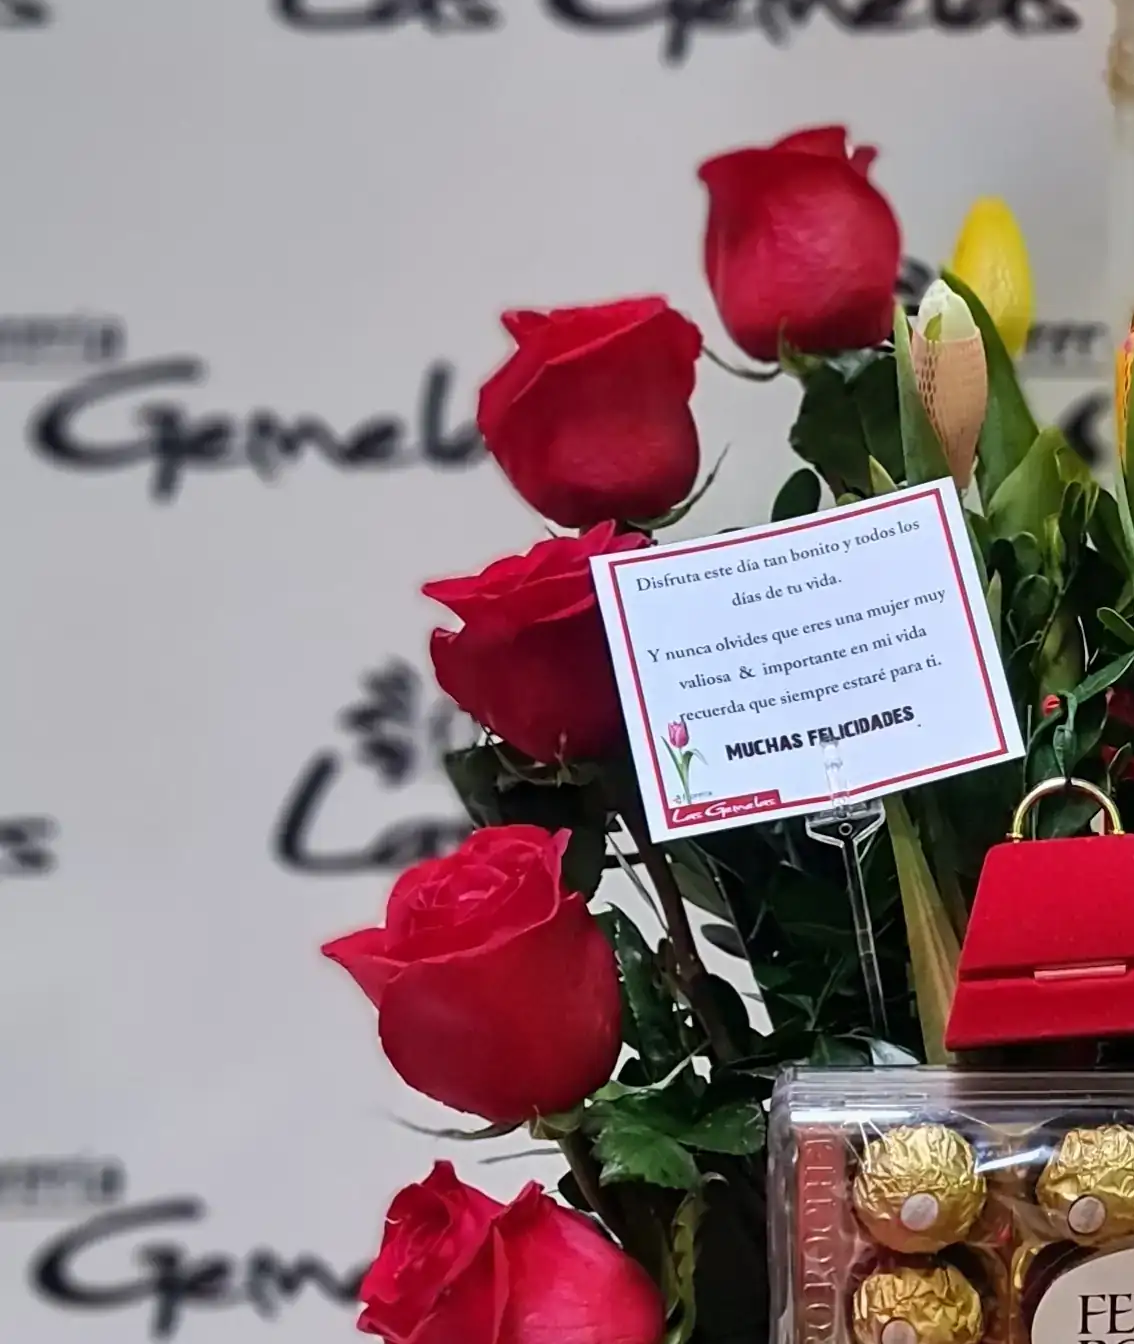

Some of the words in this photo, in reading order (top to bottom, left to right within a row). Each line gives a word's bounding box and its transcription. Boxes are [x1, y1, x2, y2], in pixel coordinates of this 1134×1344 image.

[28, 357, 486, 503] Gemel
[636, 573, 701, 591] Disfruta
[704, 567, 733, 580] este
[737, 559, 760, 573] día
[764, 554, 788, 567] tan
[789, 542, 840, 562] bonito
[842, 539, 851, 553] y
[854, 527, 896, 545] todos
[897, 520, 920, 534] los
[732, 592, 761, 606] días
[765, 586, 783, 599] de
[787, 583, 803, 595] tu
[806, 573, 842, 591] vida.
[647, 648, 660, 663] Y
[665, 644, 712, 661] nunca
[715, 632, 768, 651] olvides
[771, 627, 799, 645] que
[802, 619, 832, 634] eres
[834, 612, 863, 626] una
[866, 599, 909, 618] mujer
[913, 589, 945, 606] muy
[678, 673, 731, 690] valiosa
[739, 665, 756, 679] &
[762, 648, 847, 676] importante
[850, 643, 869, 655] en
[872, 634, 893, 650] mi
[896, 625, 927, 643] vida
[679, 700, 746, 723] recuerda
[749, 696, 777, 714] que
[781, 684, 840, 704] siempre
[842, 667, 886, 690] estaré
[890, 660, 923, 682] para
[925, 654, 942, 668] ti.
[725, 732, 803, 761] MUCHAS
[806, 705, 915, 746] FELICIDADES
[672, 809, 703, 823] Las
